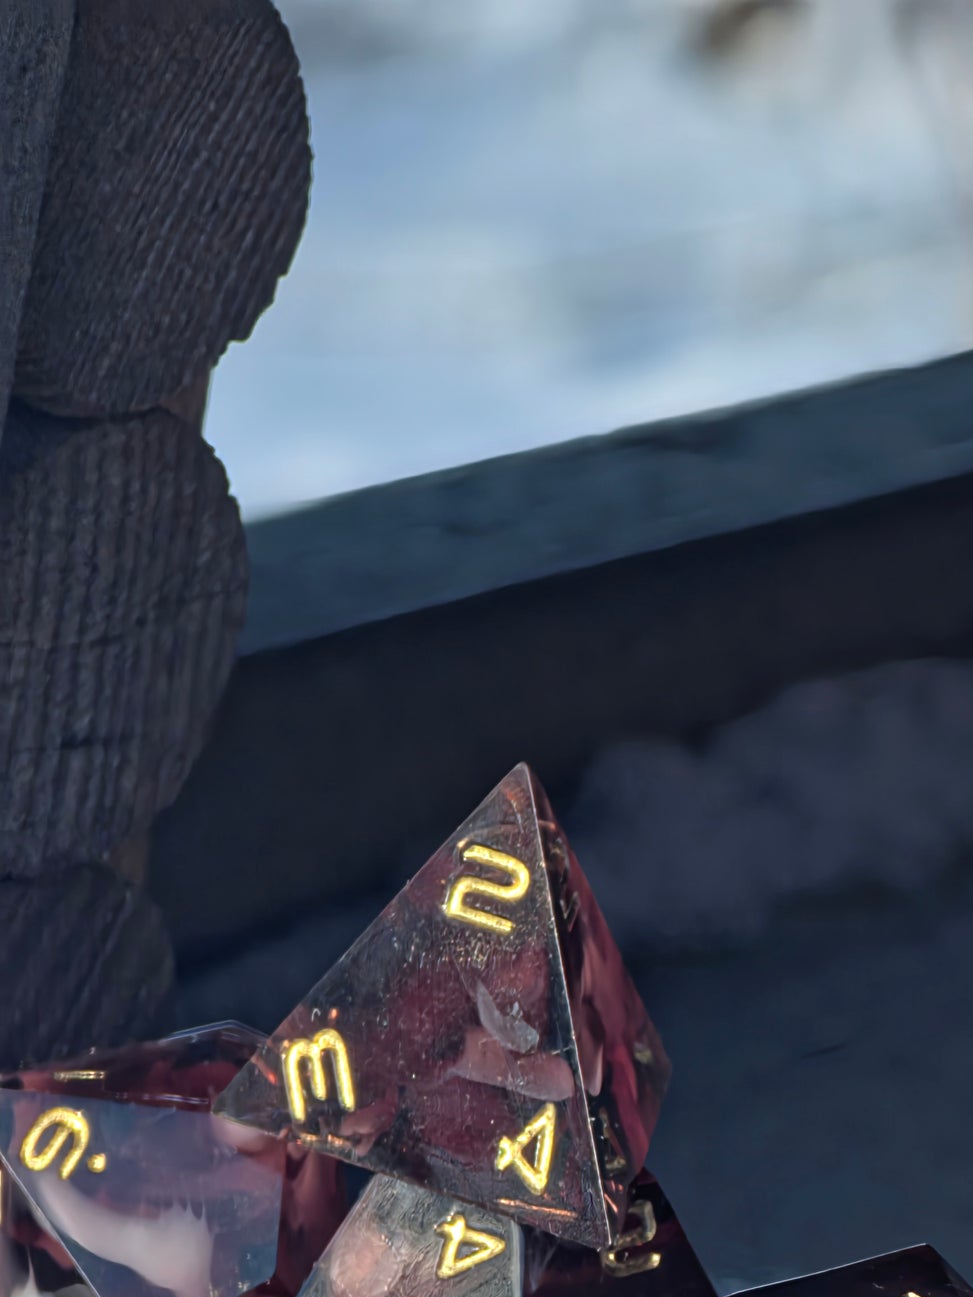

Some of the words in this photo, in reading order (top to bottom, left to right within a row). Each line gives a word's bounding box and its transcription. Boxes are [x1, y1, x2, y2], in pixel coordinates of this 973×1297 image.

[444, 838, 531, 934] 2
[281, 1029, 355, 1122] 3
[494, 1102, 558, 1196] 4
[435, 1211, 506, 1280] 4
